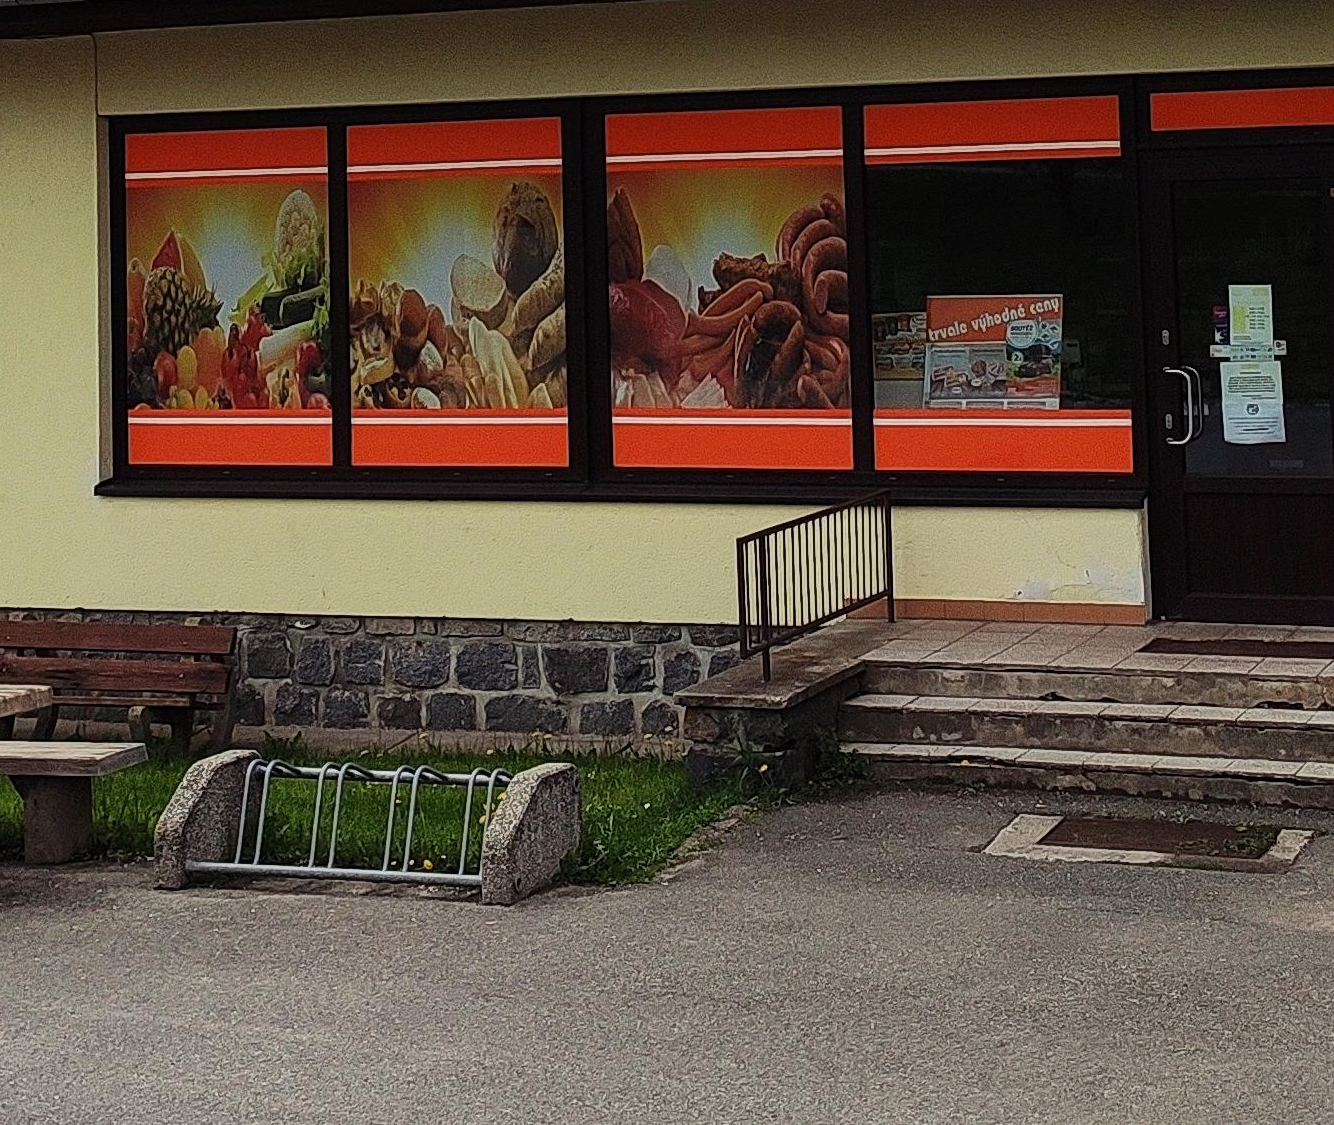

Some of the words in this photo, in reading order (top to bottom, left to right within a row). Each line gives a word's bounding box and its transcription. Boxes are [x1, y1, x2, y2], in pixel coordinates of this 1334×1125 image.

[928, 321, 968, 342] trvale
[971, 303, 1026, 333] výhodné
[1029, 298, 1060, 313] ceny
